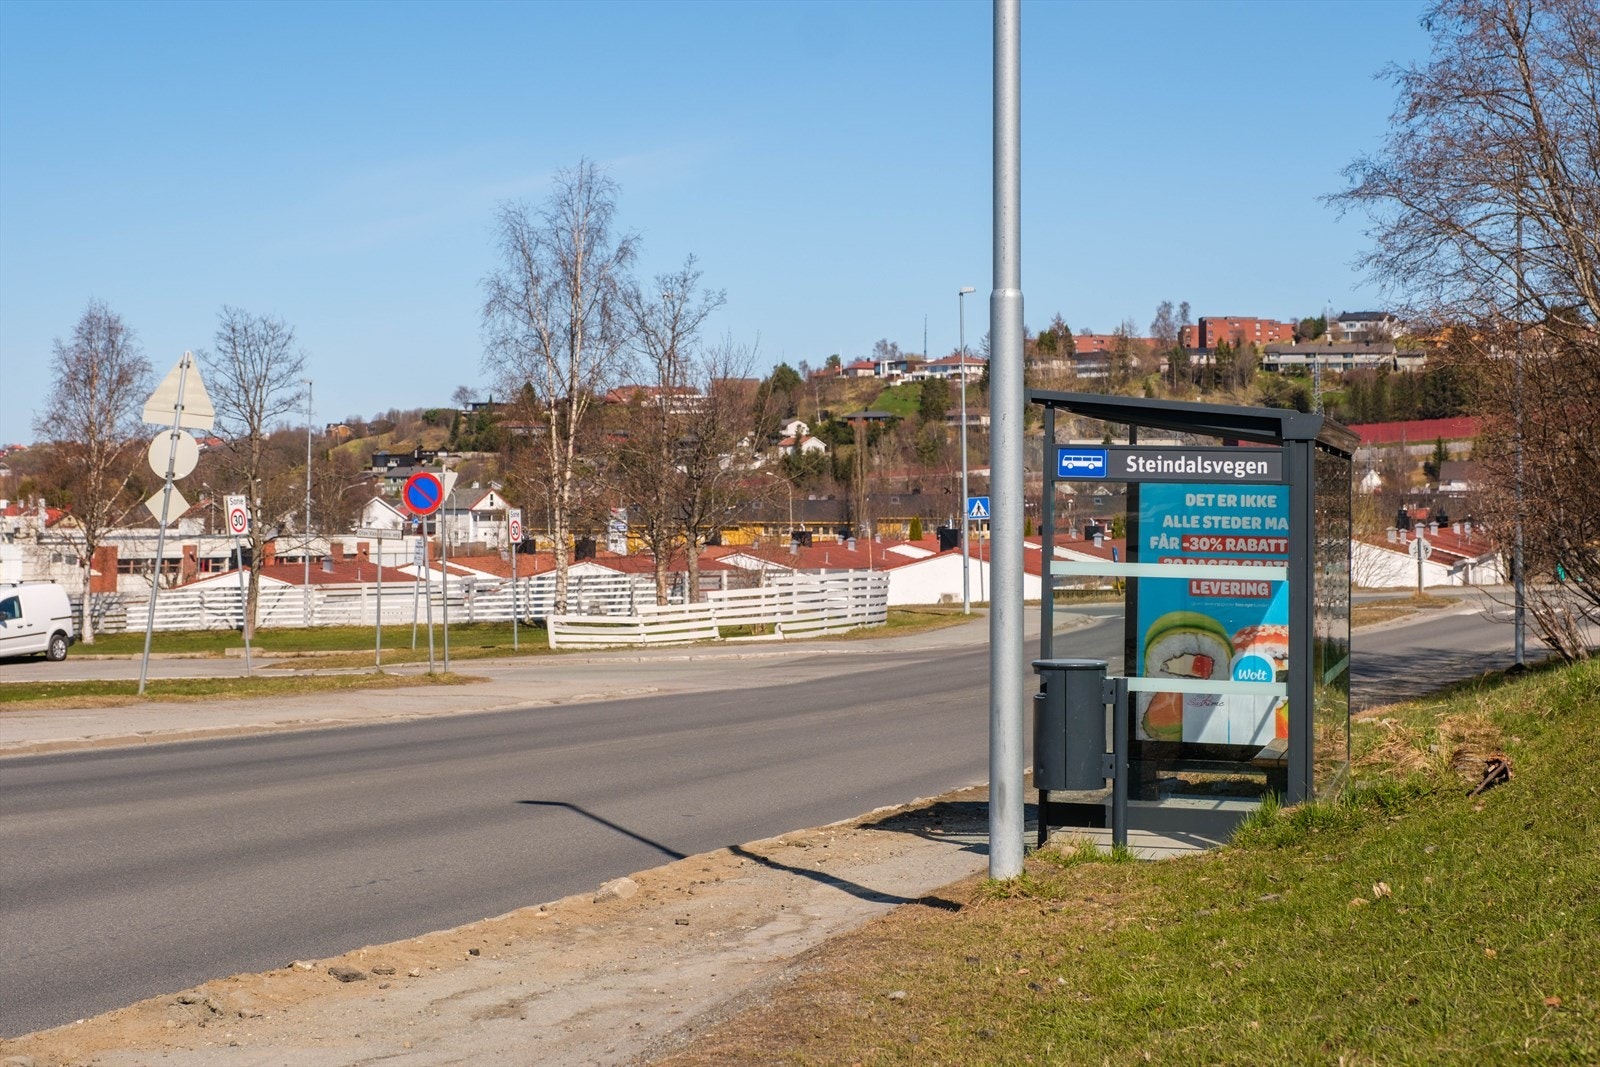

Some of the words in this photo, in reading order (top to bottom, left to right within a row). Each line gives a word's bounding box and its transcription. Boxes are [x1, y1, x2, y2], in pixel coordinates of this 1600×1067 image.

[1126, 455, 1268, 478] Steindalsvegen
[230, 497, 244, 506] Sone
[1185, 493, 1215, 507] DET
[1217, 494, 1238, 508] ER
[1240, 494, 1277, 508] IKKE
[233, 515, 244, 527] 30
[510, 510, 520, 518] Sone
[1162, 514, 1200, 529] ALLE
[1202, 515, 1262, 530] STEDER
[1264, 516, 1289, 530] MA
[512, 525, 519, 536] 30
[1149, 532, 1180, 550] FÅR
[1182, 536, 1223, 551] -30%
[1225, 537, 1288, 552] RABATT
[1191, 581, 1269, 596] LEVERING
[1238, 668, 1267, 681] Wolt
